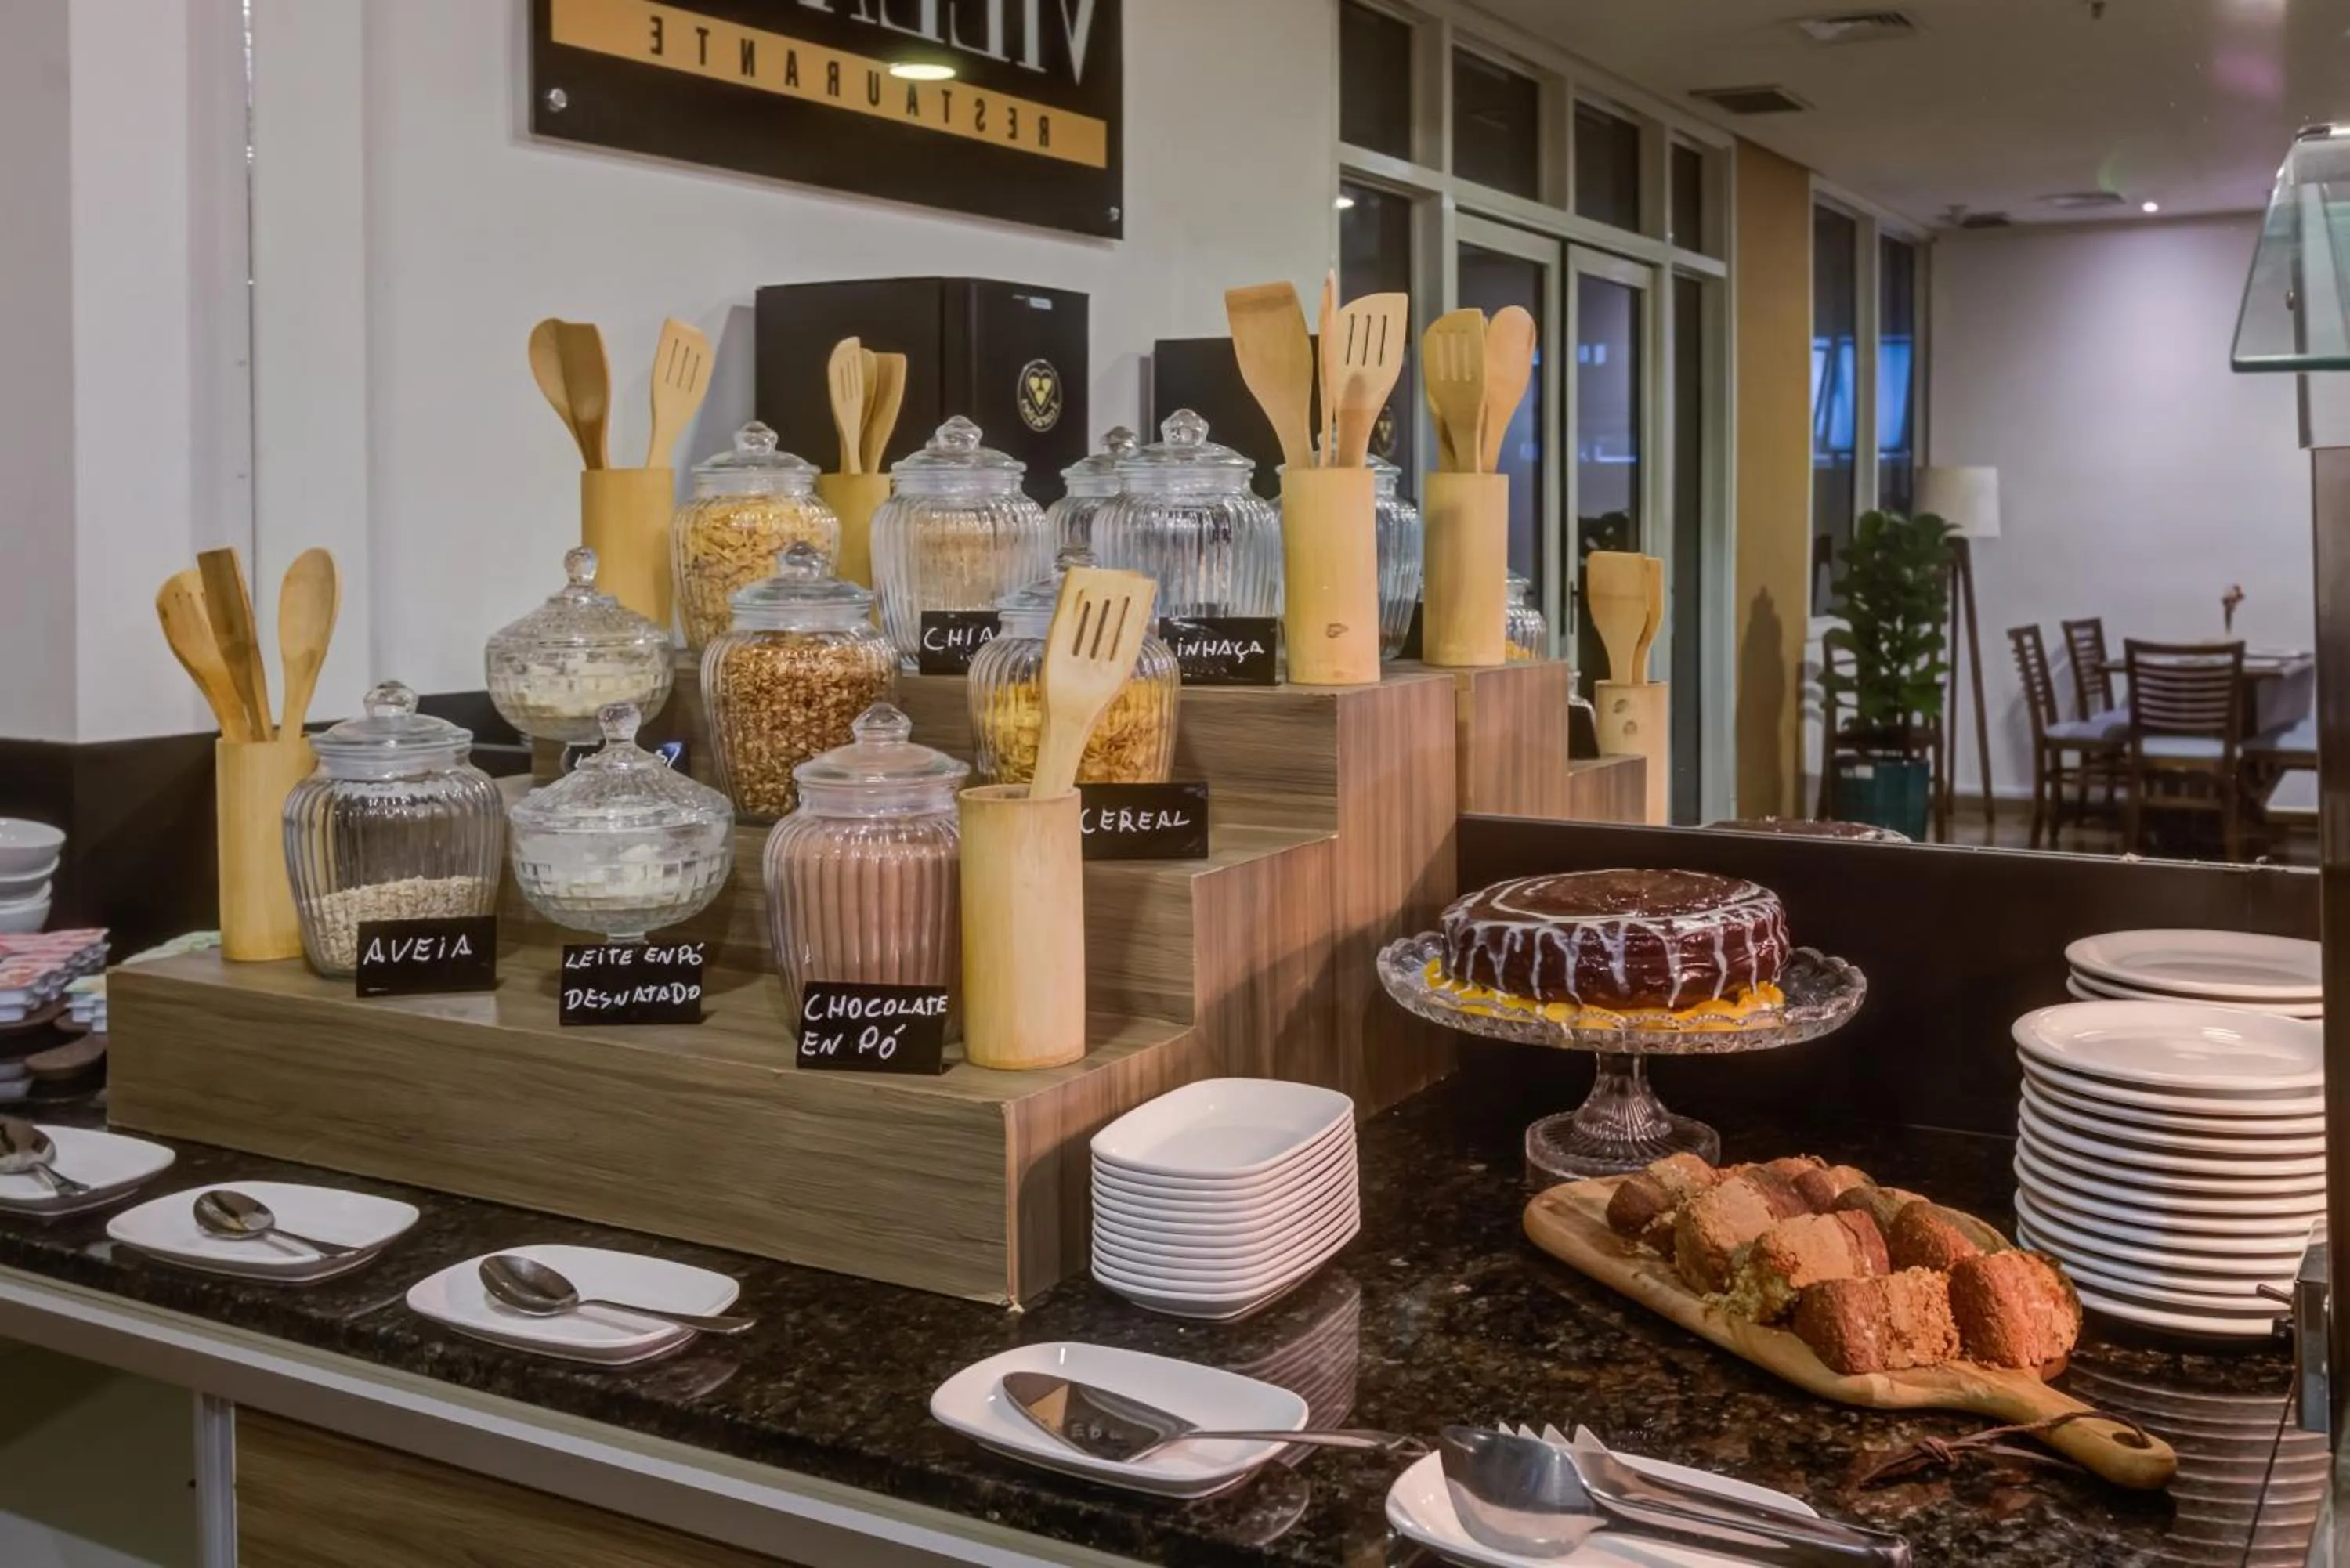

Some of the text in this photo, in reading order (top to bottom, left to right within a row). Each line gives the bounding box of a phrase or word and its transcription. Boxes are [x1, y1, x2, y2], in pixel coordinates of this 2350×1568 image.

[924, 627, 993, 650] CHIA
[1163, 637, 1265, 663] INHAÇA
[1080, 807, 1191, 834] CEREAL
[363, 934, 473, 966] AVEIA
[565, 947, 634, 970] LEITE
[564, 981, 702, 1010] DESNATADO
[804, 993, 949, 1021] CHOCOLATE
[801, 1024, 906, 1060] EN PÓ
